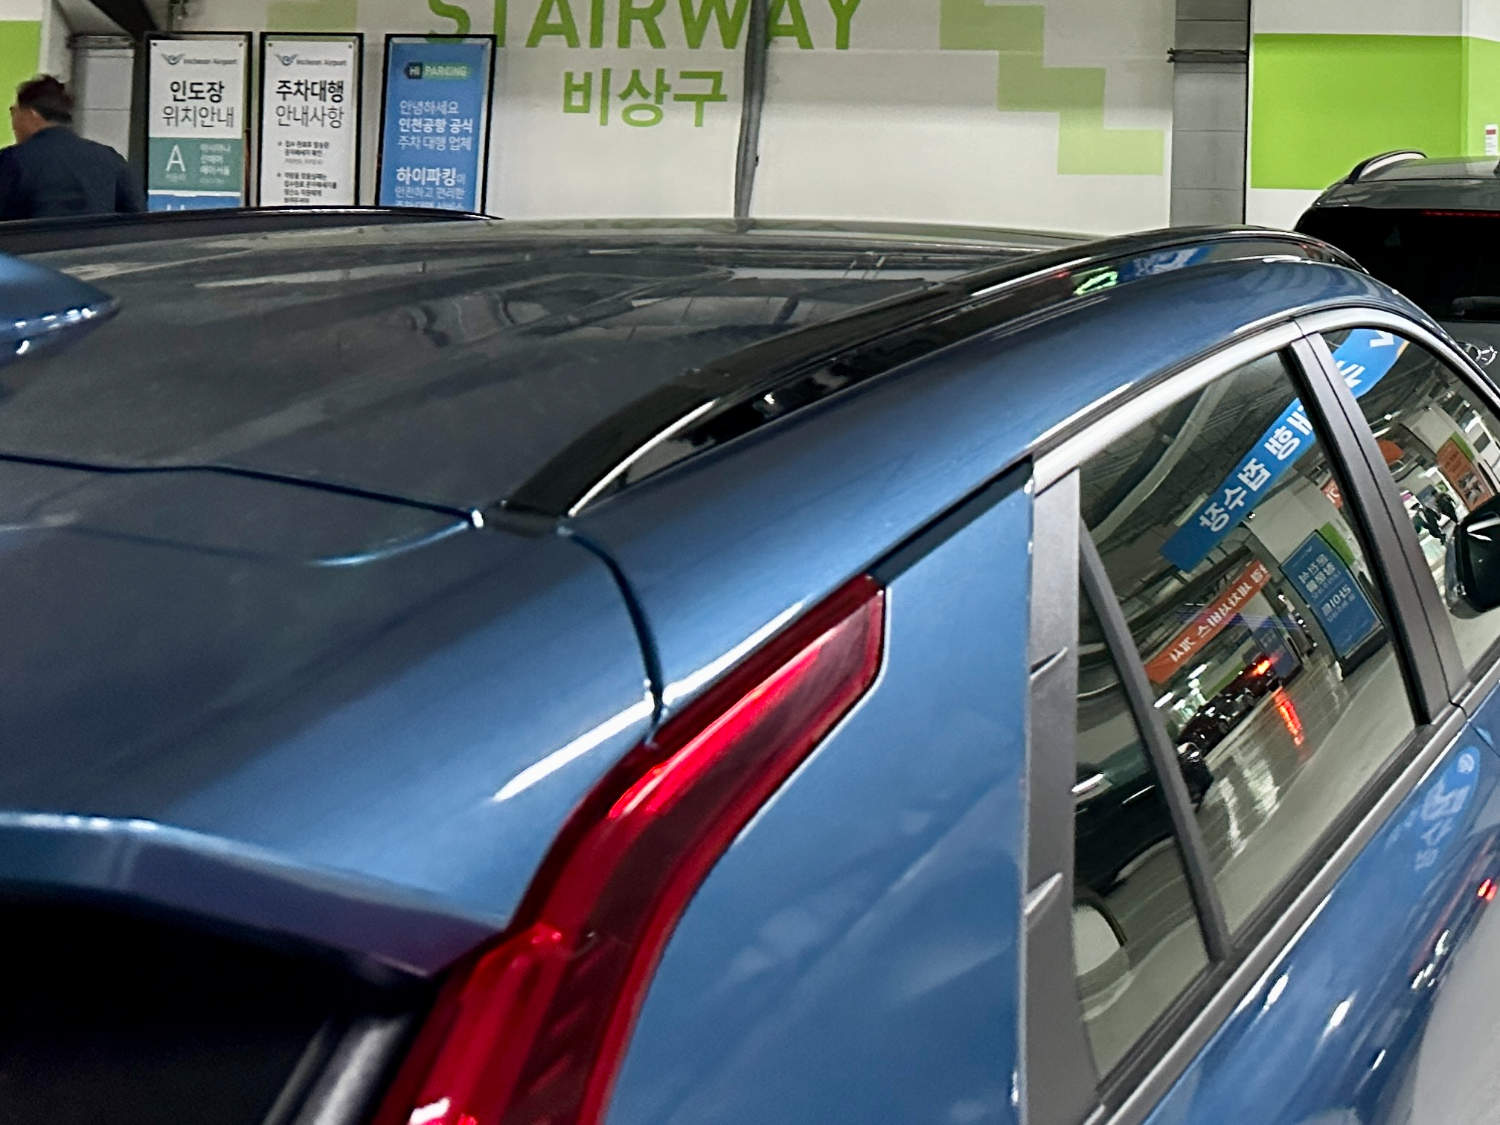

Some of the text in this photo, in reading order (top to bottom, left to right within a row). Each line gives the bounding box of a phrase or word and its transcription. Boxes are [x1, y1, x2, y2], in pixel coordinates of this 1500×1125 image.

[170, 80, 225, 103] 인도장
[276, 79, 344, 103] 주차대행
[562, 68, 728, 127] 비상구
[162, 105, 234, 127] 위치안내
[276, 105, 344, 129] 안내사항
[399, 100, 460, 115] 안녕하세요
[398, 118, 474, 134] 인천공항 공식
[449, 136, 472, 151] 업체
[165, 144, 186, 172] A
